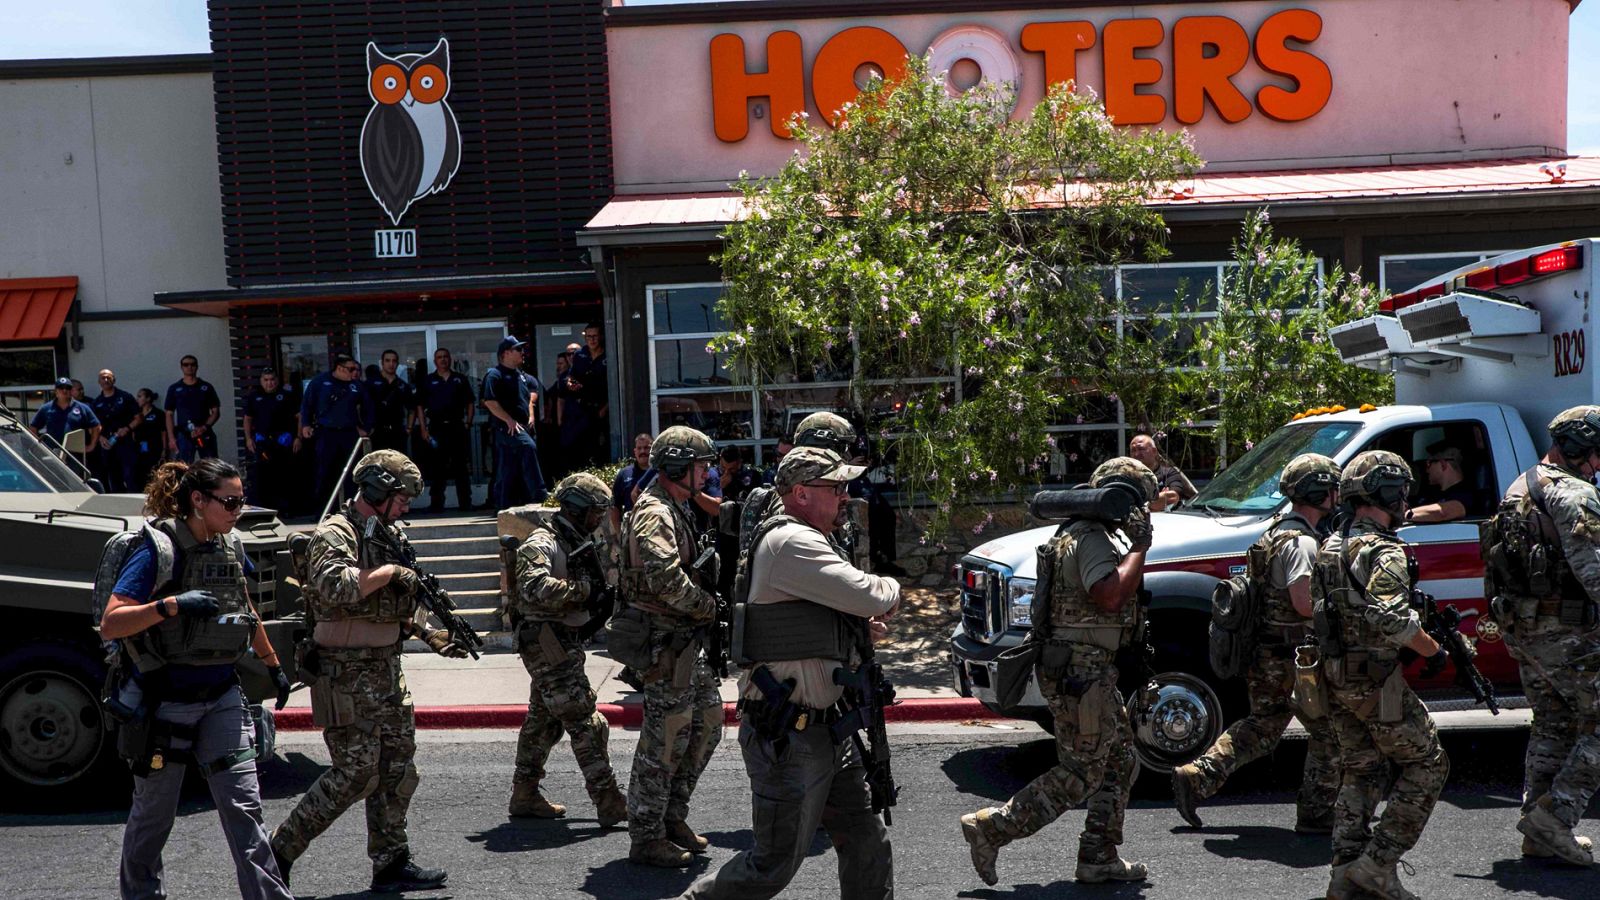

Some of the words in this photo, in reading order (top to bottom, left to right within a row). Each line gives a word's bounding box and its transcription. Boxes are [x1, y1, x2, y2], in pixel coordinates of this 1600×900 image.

[710, 9, 1333, 142] HOOTERS
[377, 231, 414, 256] 1170
[1553, 328, 1585, 377] RR29
[206, 563, 235, 577] FBI
